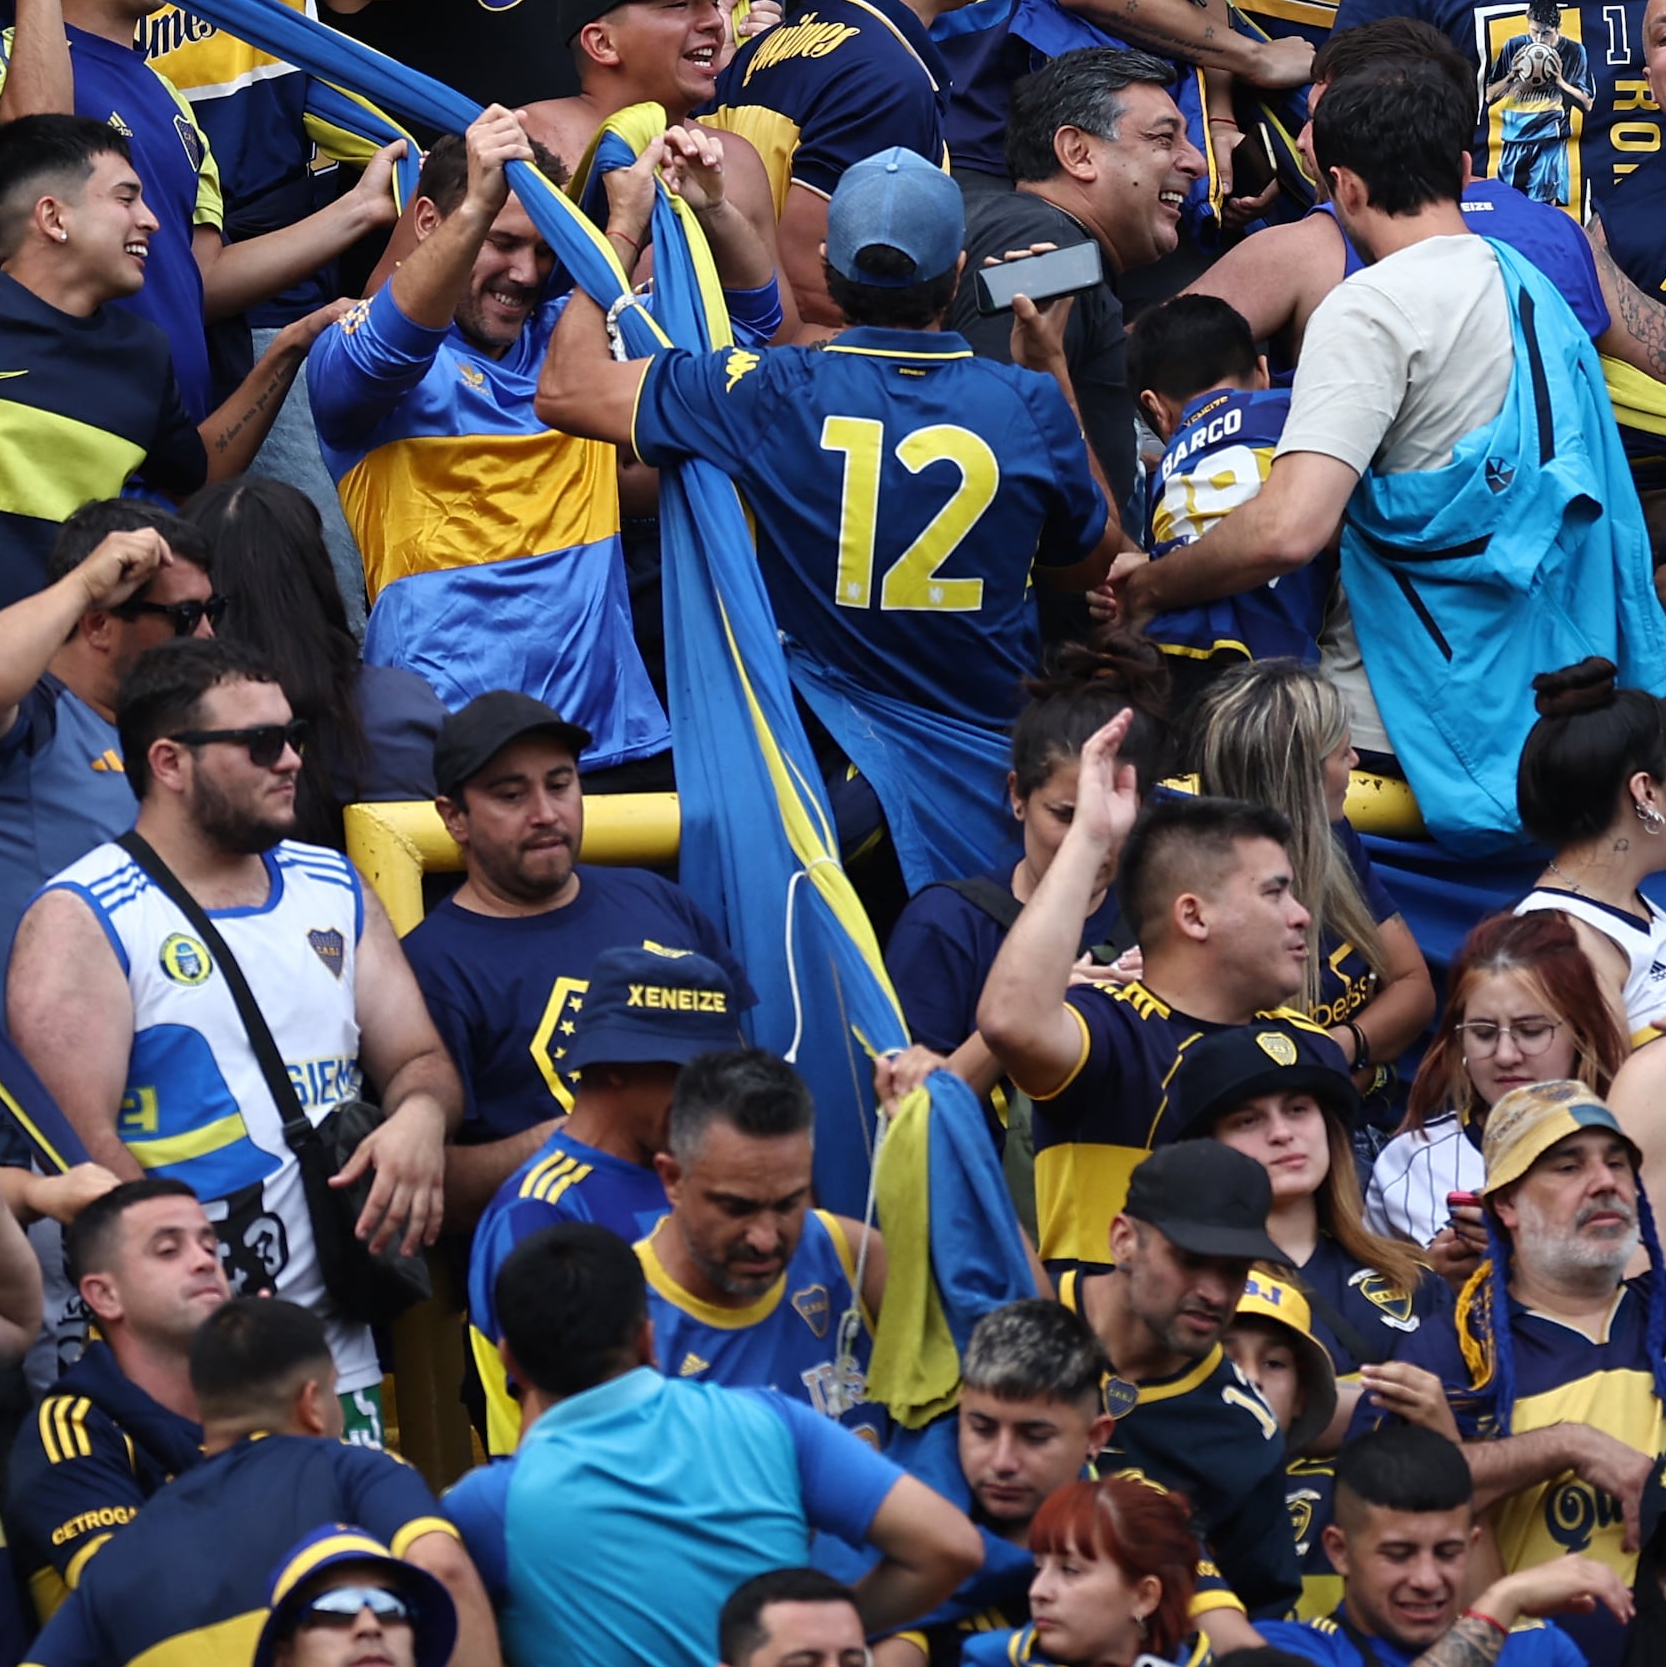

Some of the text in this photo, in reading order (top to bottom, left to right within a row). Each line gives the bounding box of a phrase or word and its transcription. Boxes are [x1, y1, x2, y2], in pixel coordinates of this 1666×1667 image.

[133, 10, 219, 63] lmes
[1460, 201, 1494, 212] EIZE
[1162, 409, 1242, 482] BARCO
[819, 415, 1001, 612] 12
[626, 984, 727, 1013] XENEIZE
[51, 1506, 138, 1546] CETROG
